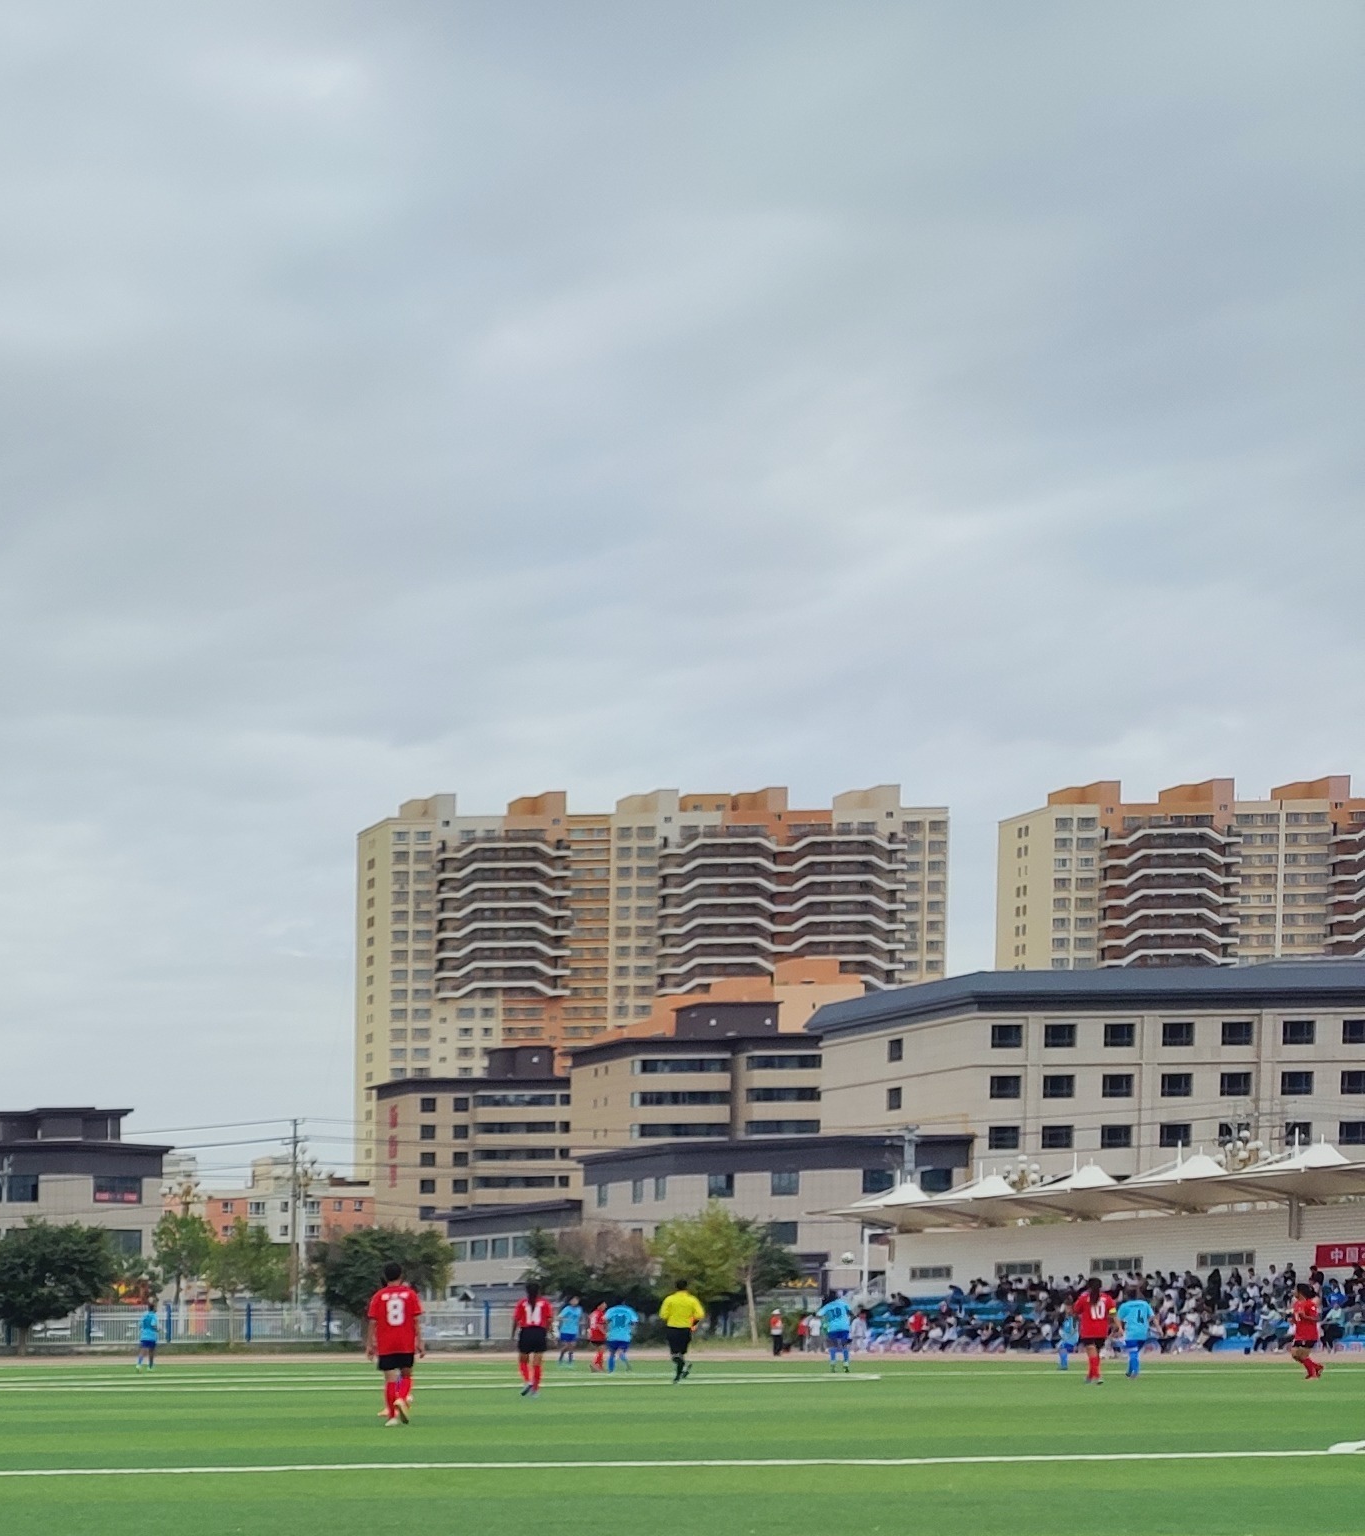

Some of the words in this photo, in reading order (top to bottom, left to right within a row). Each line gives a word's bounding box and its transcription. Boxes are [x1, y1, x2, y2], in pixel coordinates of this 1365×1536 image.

[1330, 1248, 1365, 1264] 中国
[386, 1299, 405, 1326] 8
[1090, 1301, 1106, 1320] 10
